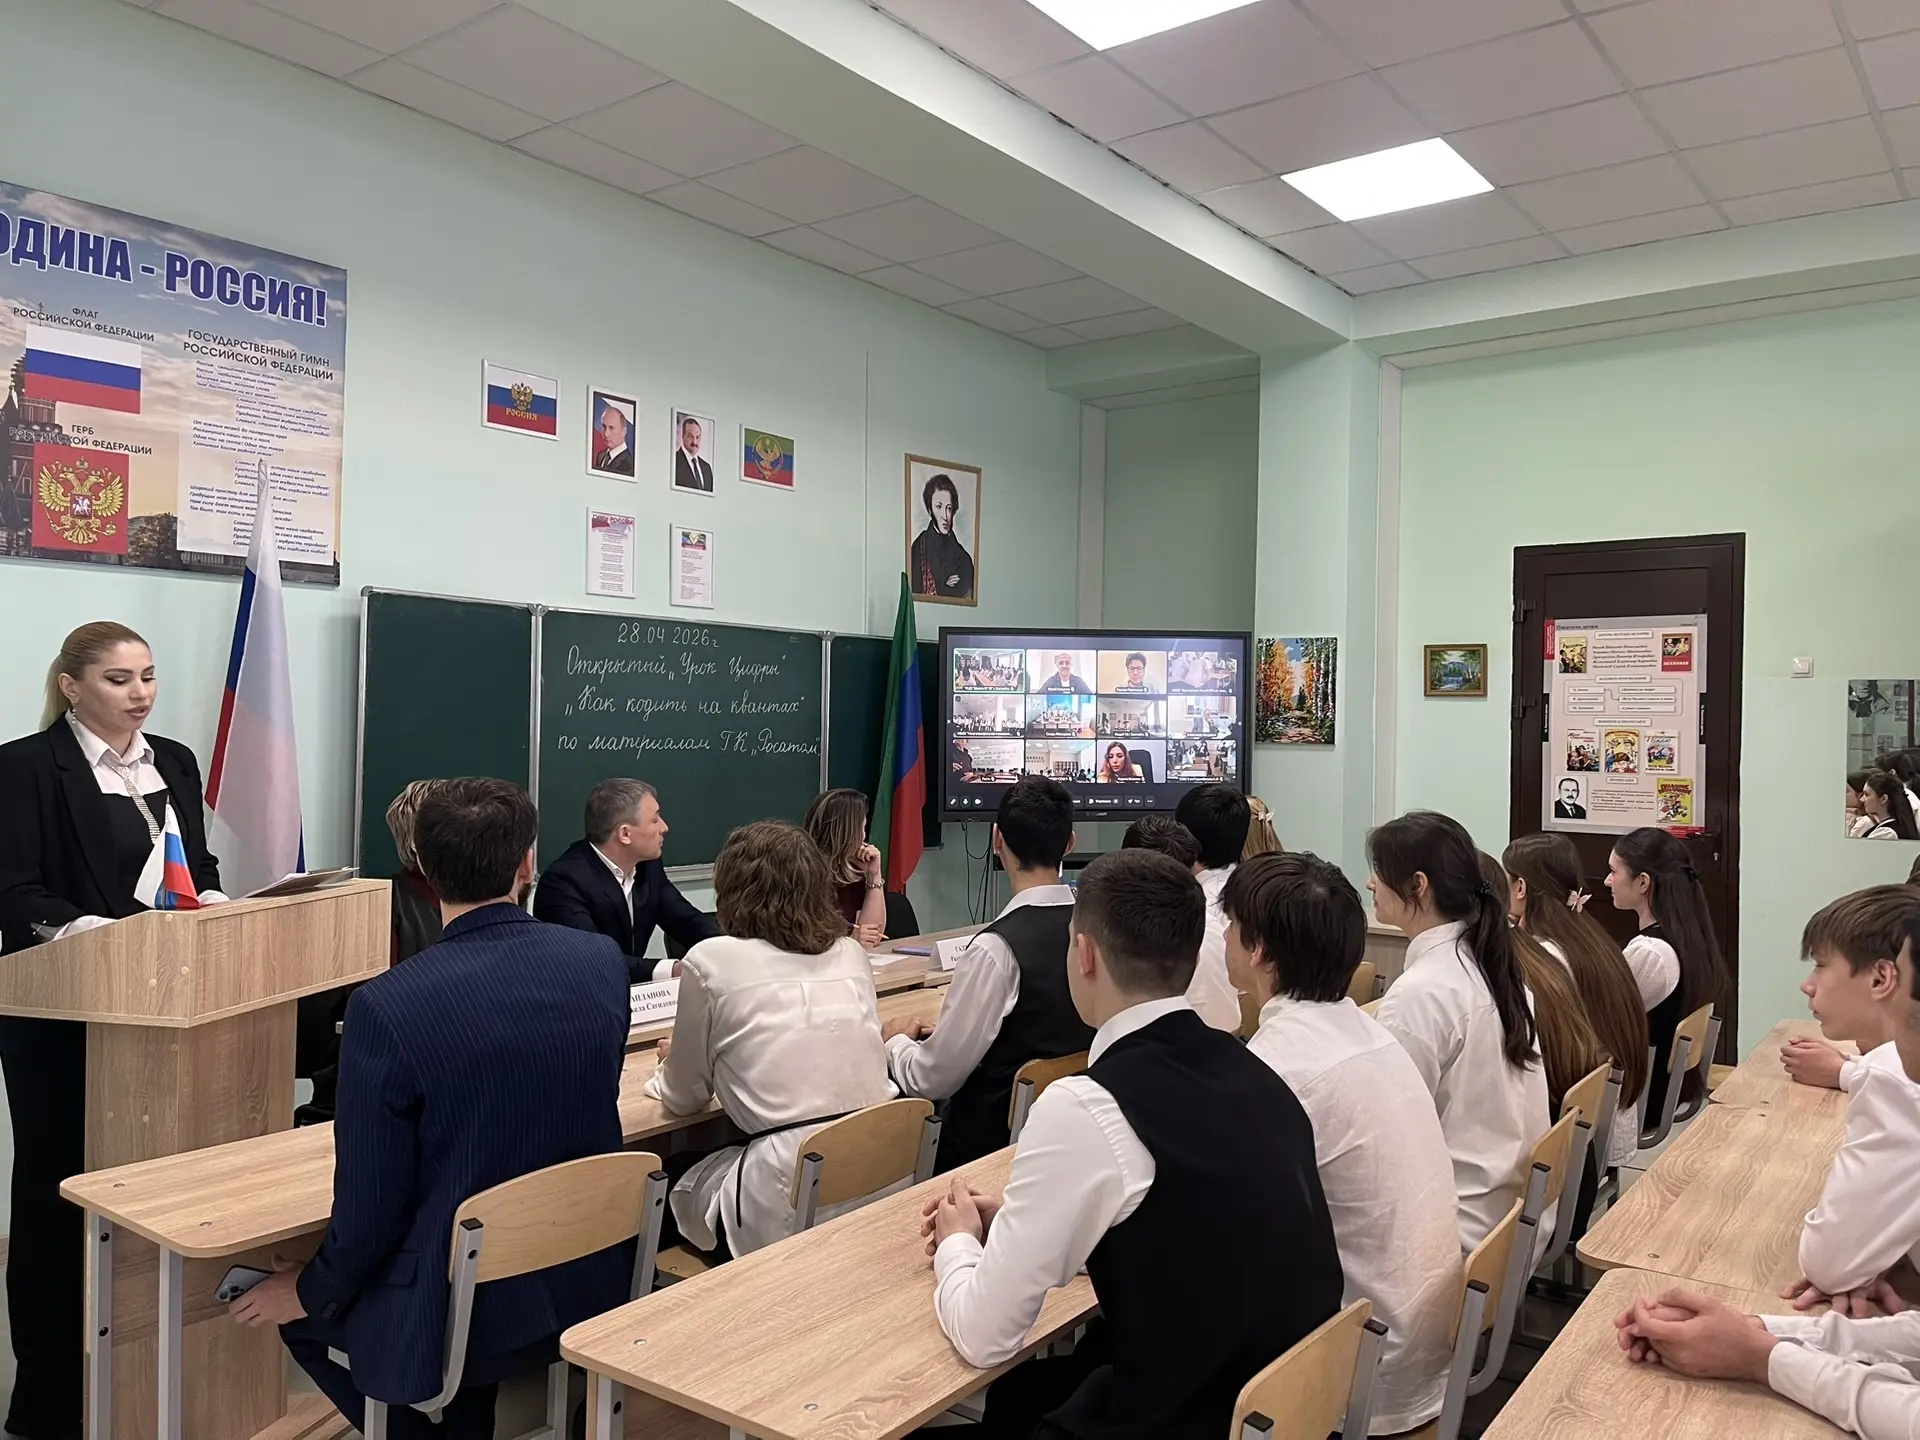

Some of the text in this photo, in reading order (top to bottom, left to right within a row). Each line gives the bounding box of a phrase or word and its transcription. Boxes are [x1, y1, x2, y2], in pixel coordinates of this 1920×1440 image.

[165, 251, 327, 327] РОССИЯ!
[14, 307, 155, 342] РОССИЙСКОЙ ФЕДЕРАЦИИ
[73, 307, 98, 319] ФЛАГ
[184, 342, 333, 380] РОССИЙСКОЙ ФЕДЕРАЦИИ
[188, 329, 330, 367] ГОСУДАРСТВЕННЫЙ ГИМН
[504, 407, 538, 421] РОССИЯ
[9, 426, 152, 455] РОССИЙСКОЙ ФЕДЕРАЦИИ
[71, 424, 94, 435] ГЕРБ
[567, 645, 666, 682] Открытый
[625, 697, 688, 721] кодить
[698, 700, 722, 715] на
[557, 735, 578, 750] по
[588, 735, 711, 760] материалам
[720, 731, 748, 753] ГК
